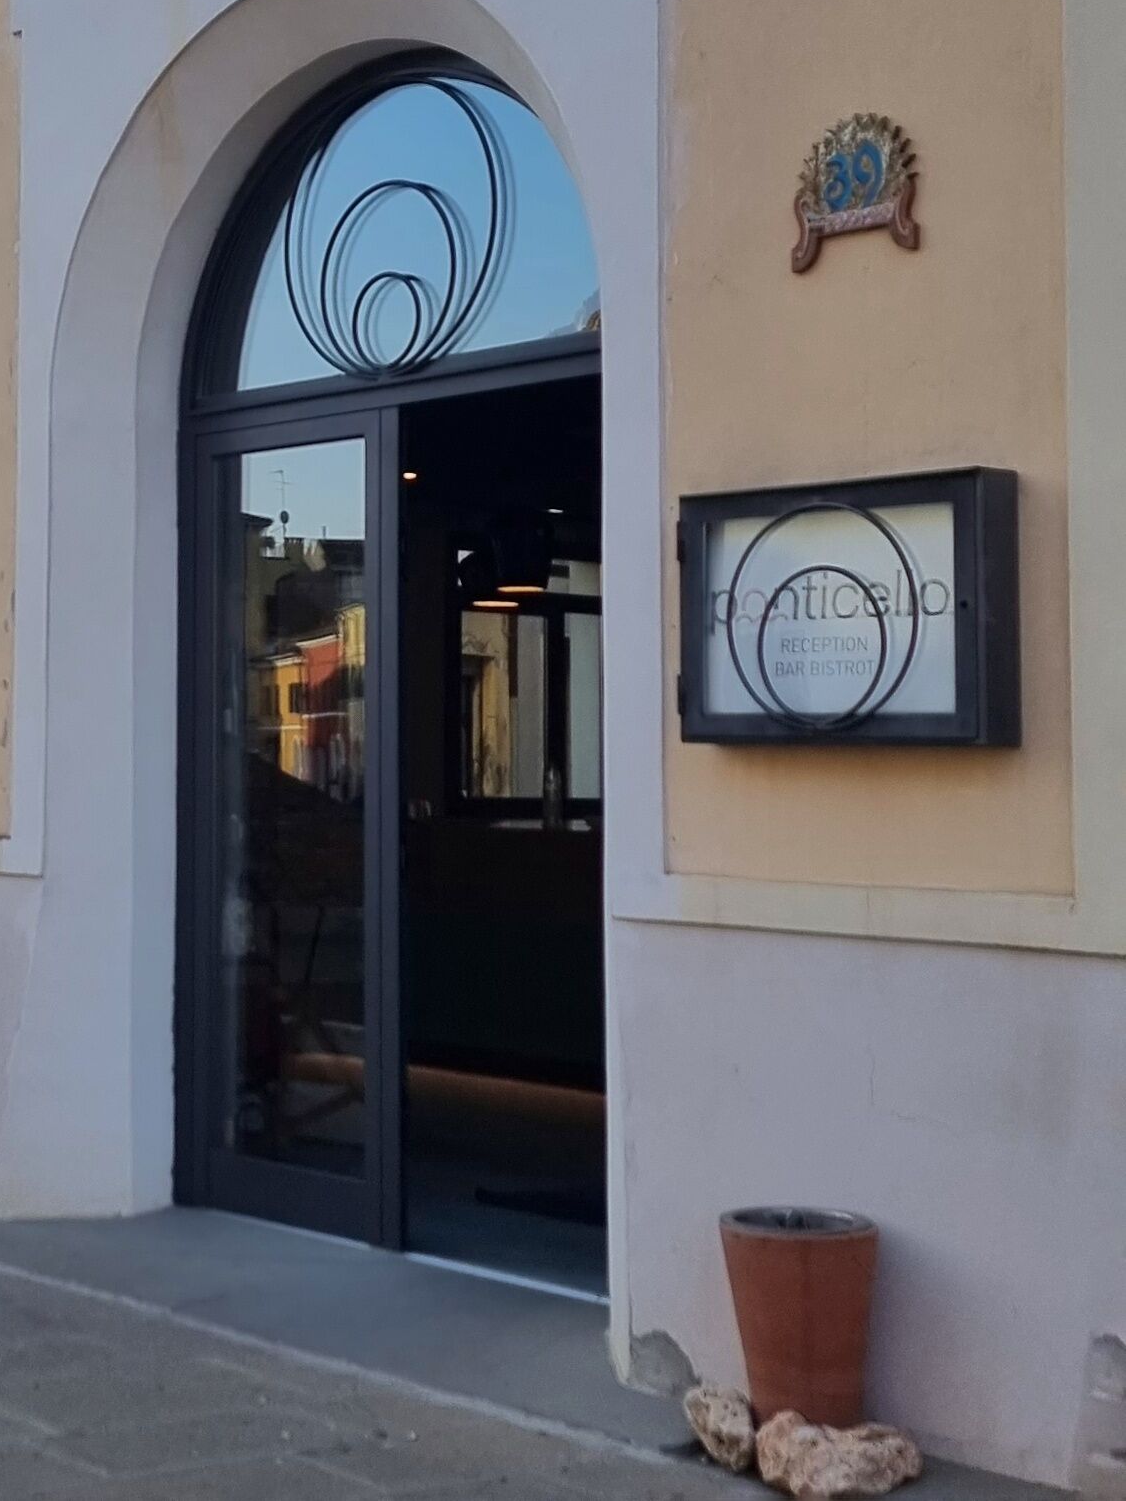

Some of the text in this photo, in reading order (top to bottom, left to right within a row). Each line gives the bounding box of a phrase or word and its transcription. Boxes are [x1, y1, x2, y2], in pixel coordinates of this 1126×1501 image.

[825, 139, 884, 213] 39
[780, 636, 869, 653] RECEPTION
[775, 659, 875, 676] BAR BISTROT
